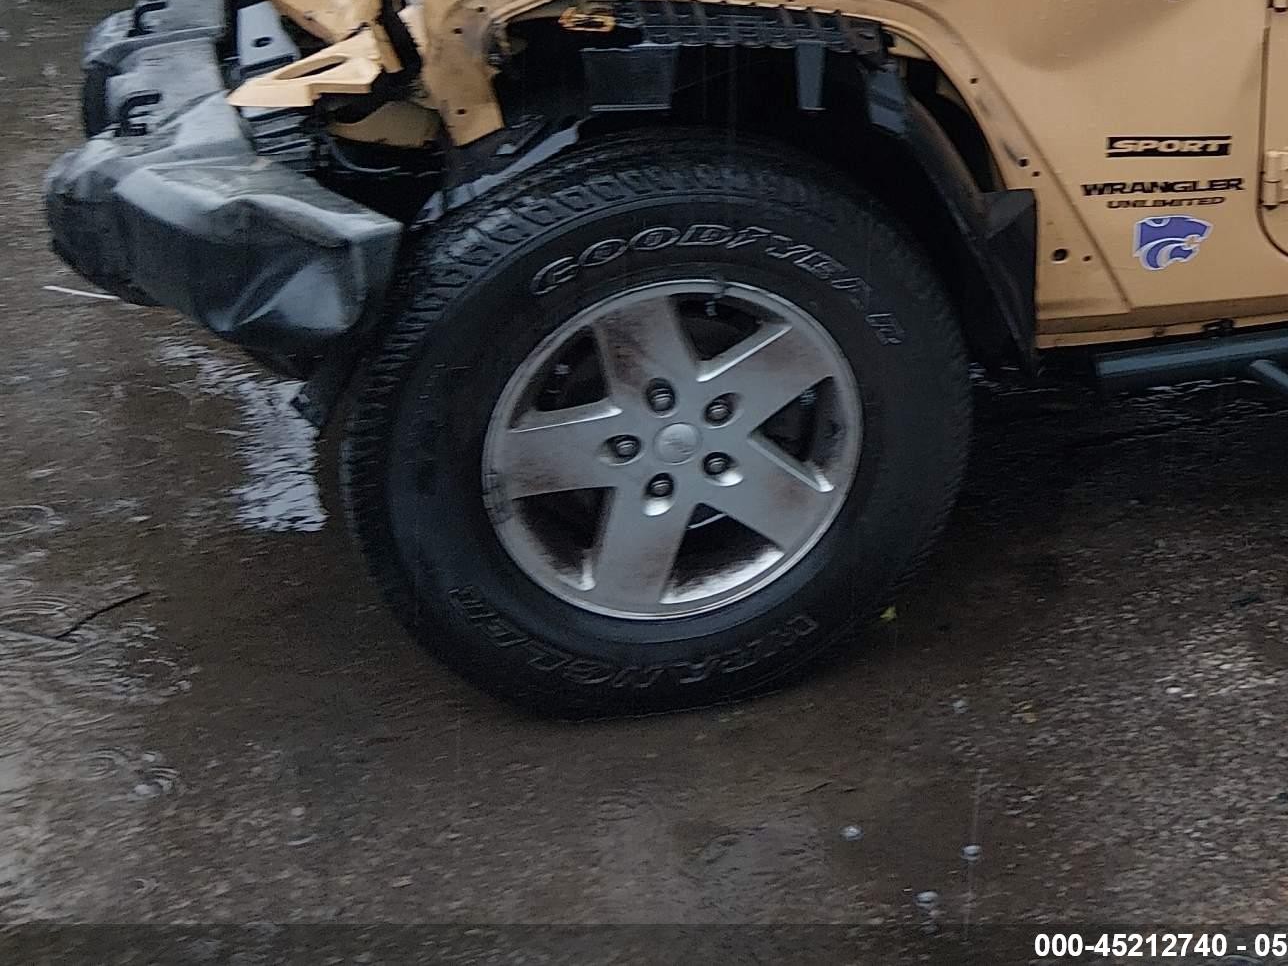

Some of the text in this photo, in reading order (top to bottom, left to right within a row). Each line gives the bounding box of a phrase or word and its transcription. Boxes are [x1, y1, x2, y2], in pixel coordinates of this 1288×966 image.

[1107, 137, 1232, 155] SPORT
[1080, 177, 1246, 196] WRANGLER
[1106, 196, 1227, 209] UNLIMITED
[528, 223, 908, 347] GOODYEAR
